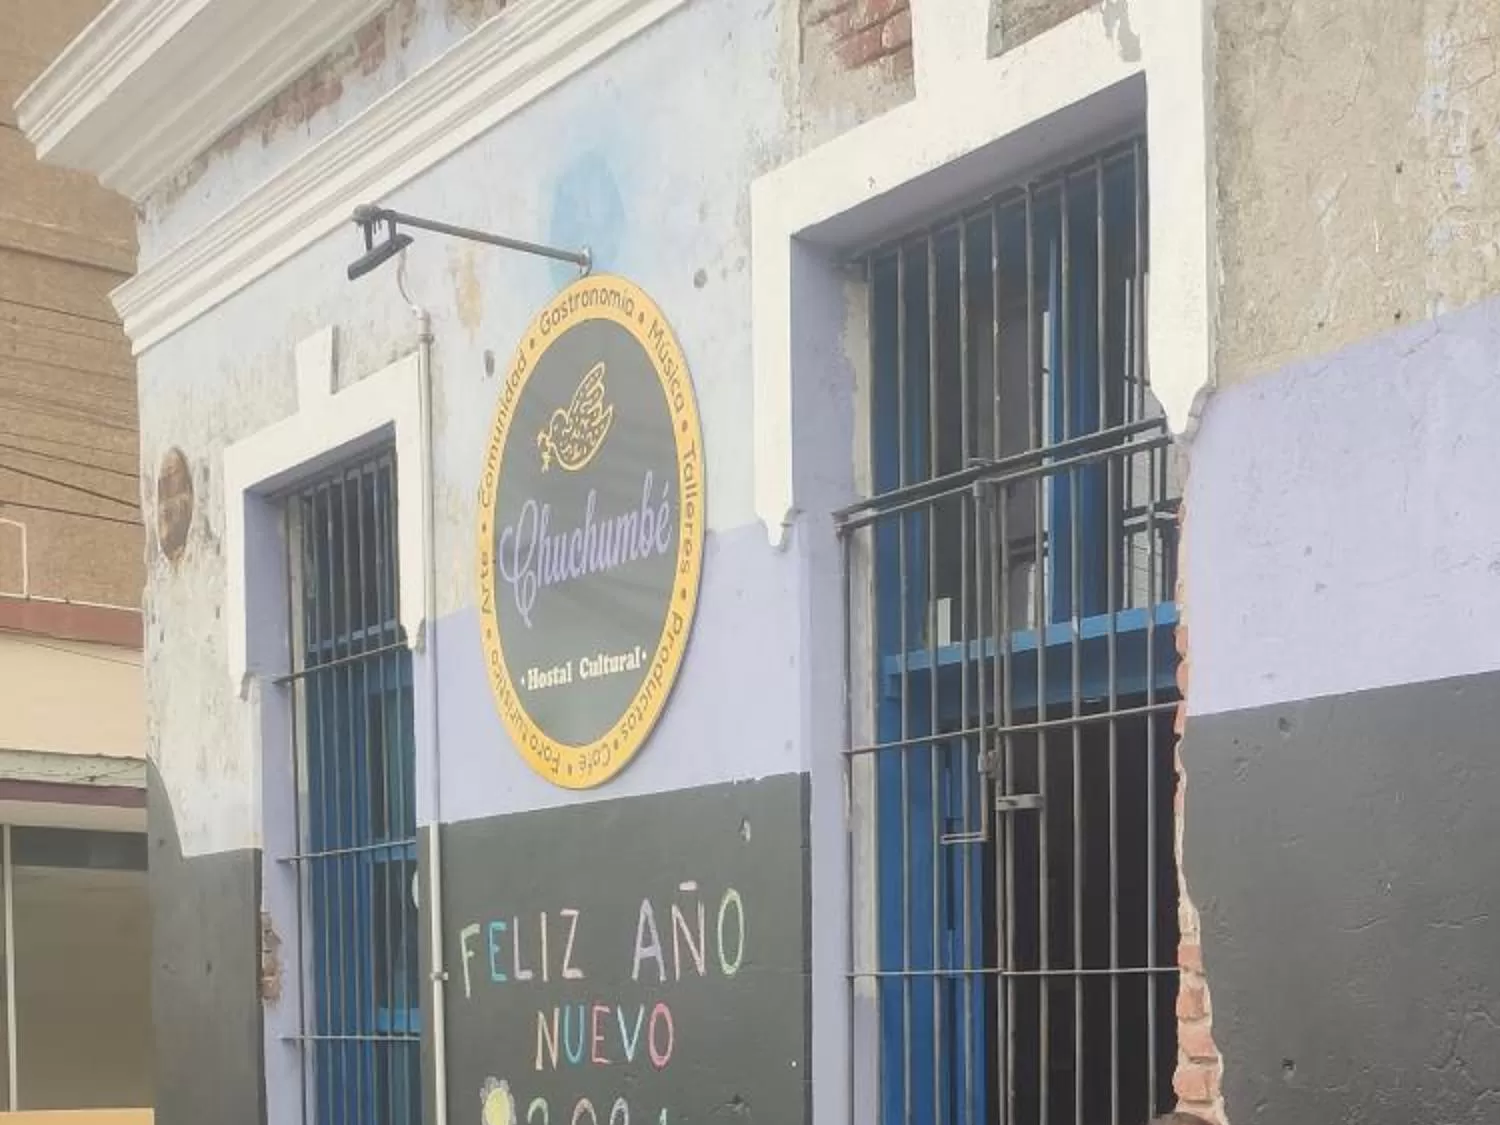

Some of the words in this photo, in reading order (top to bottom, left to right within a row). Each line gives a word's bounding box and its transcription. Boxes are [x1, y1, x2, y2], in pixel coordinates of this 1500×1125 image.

[538, 286, 635, 336] Gastronomía
[648, 319, 686, 415] Música
[478, 349, 528, 508] Comunidad
[499, 470, 673, 628] Chuchumbé
[680, 440, 699, 574] Talleres
[480, 551, 493, 614] Arte
[527, 661, 573, 691] Hostal
[579, 645, 641, 680] Cultural
[620, 611, 684, 742] Productos
[529, 733, 562, 774] Foro
[459, 908, 585, 999] FELIZ
[631, 879, 746, 981] AÑO
[535, 1003, 675, 1071] NUEVO
